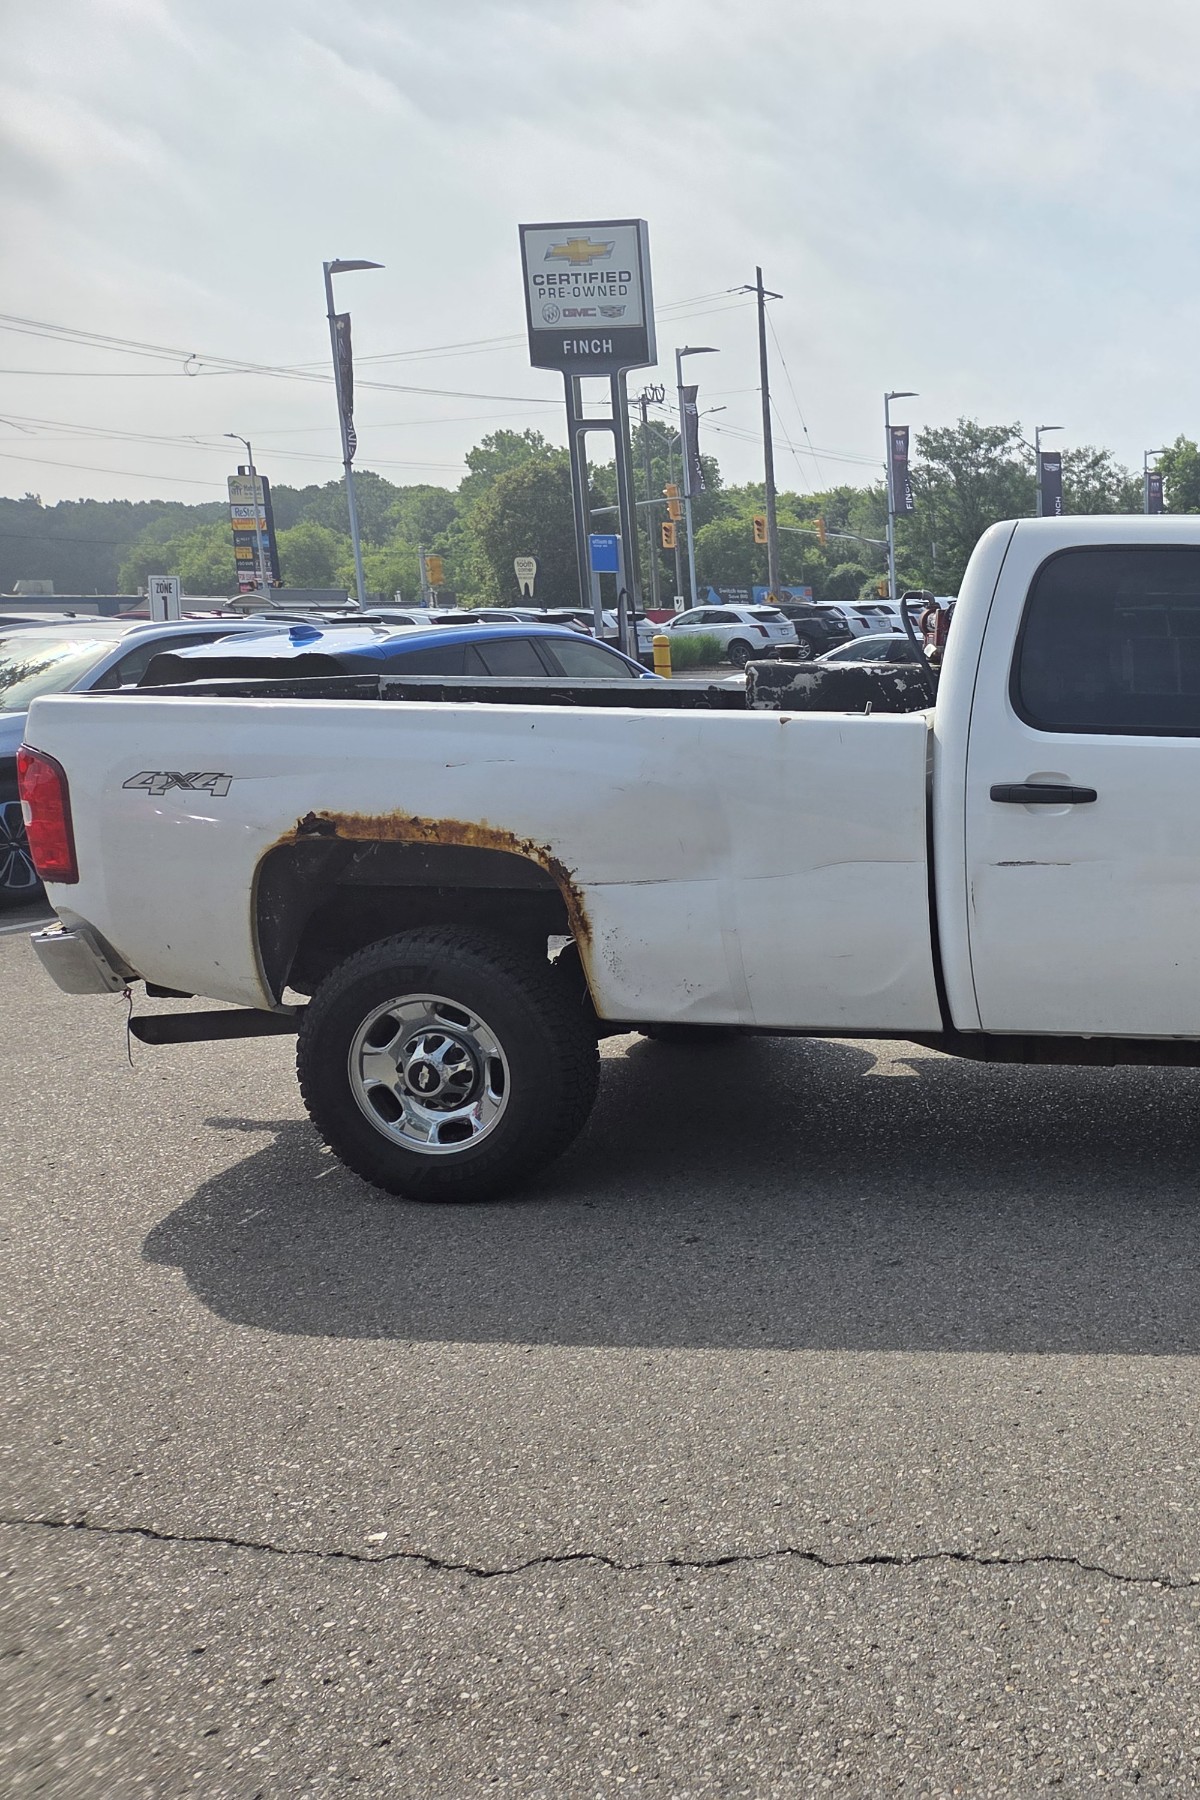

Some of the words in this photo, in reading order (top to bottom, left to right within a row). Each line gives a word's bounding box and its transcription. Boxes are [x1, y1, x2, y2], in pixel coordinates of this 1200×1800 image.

[532, 270, 632, 286] CERTIFIED
[538, 284, 628, 299] PRE-OWNED
[562, 307, 597, 318] GMC
[563, 339, 613, 354] FINCH
[155, 582, 173, 594] ZONE
[161, 596, 169, 621] 1
